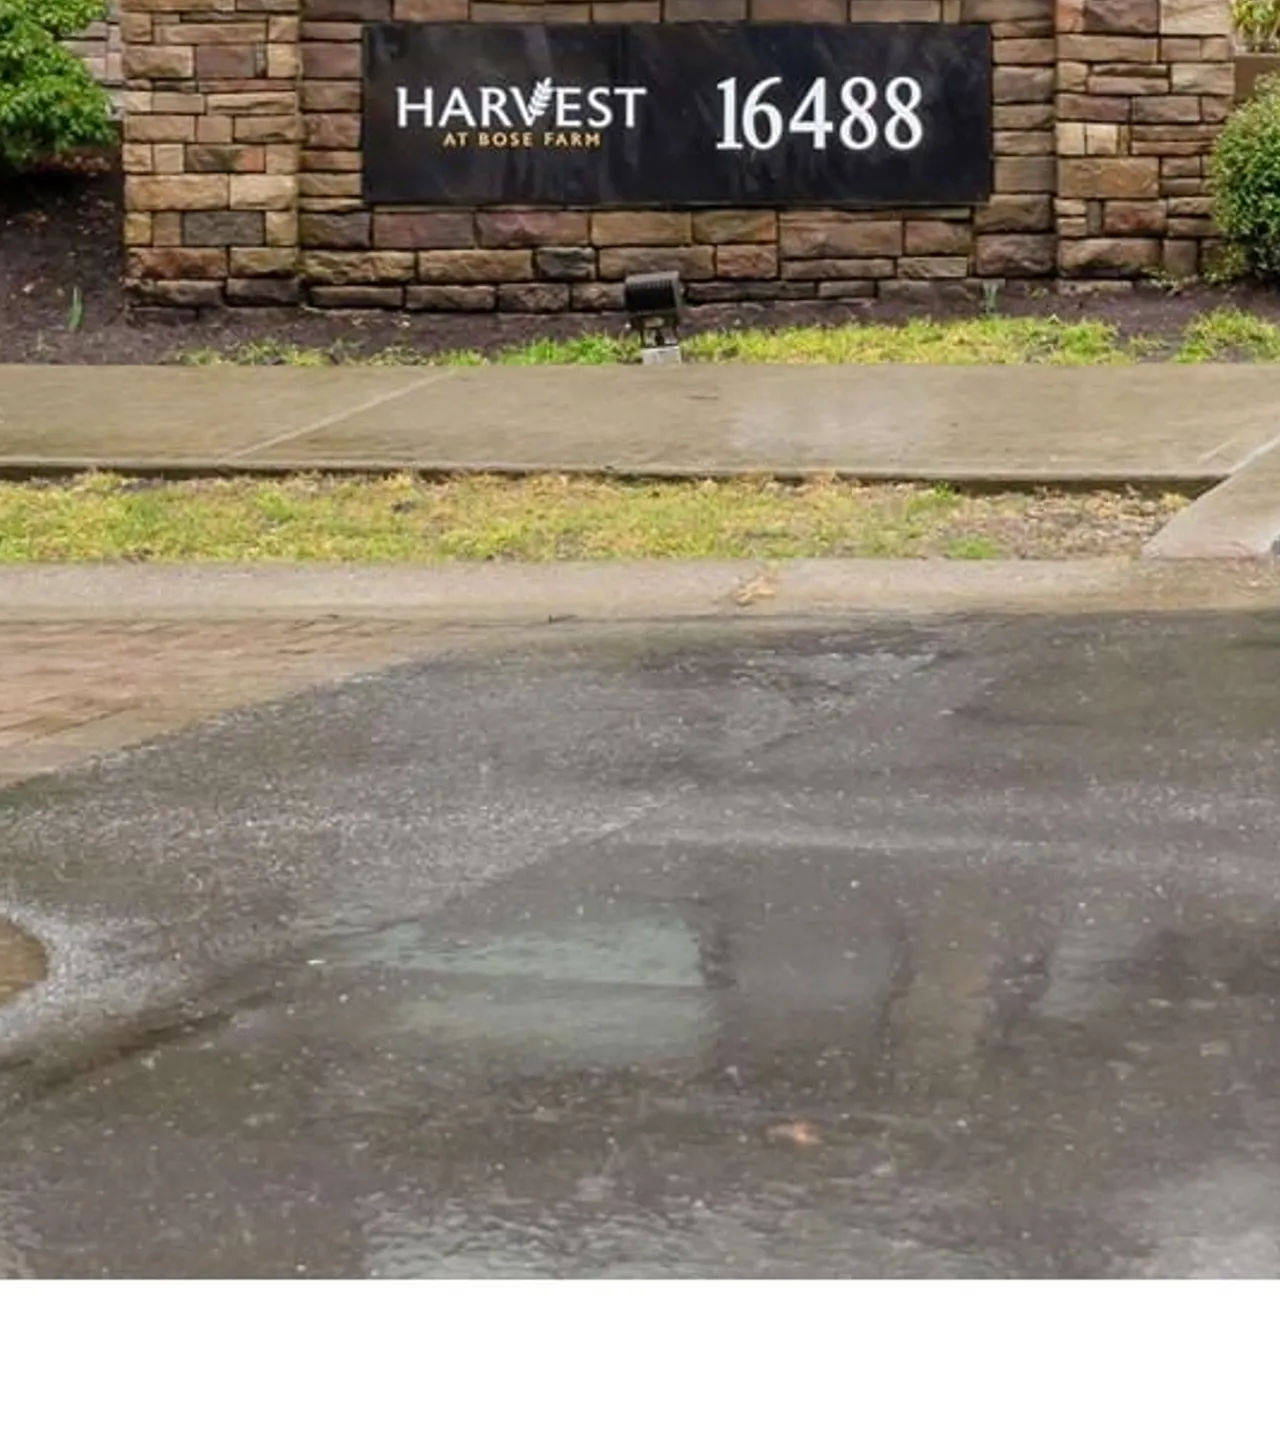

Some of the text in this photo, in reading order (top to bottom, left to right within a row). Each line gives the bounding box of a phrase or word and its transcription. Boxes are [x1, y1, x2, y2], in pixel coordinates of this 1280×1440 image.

[396, 77, 647, 128] HARVEST
[716, 75, 922, 150] 16488
[442, 132, 601, 147] AT BOSE FARM
